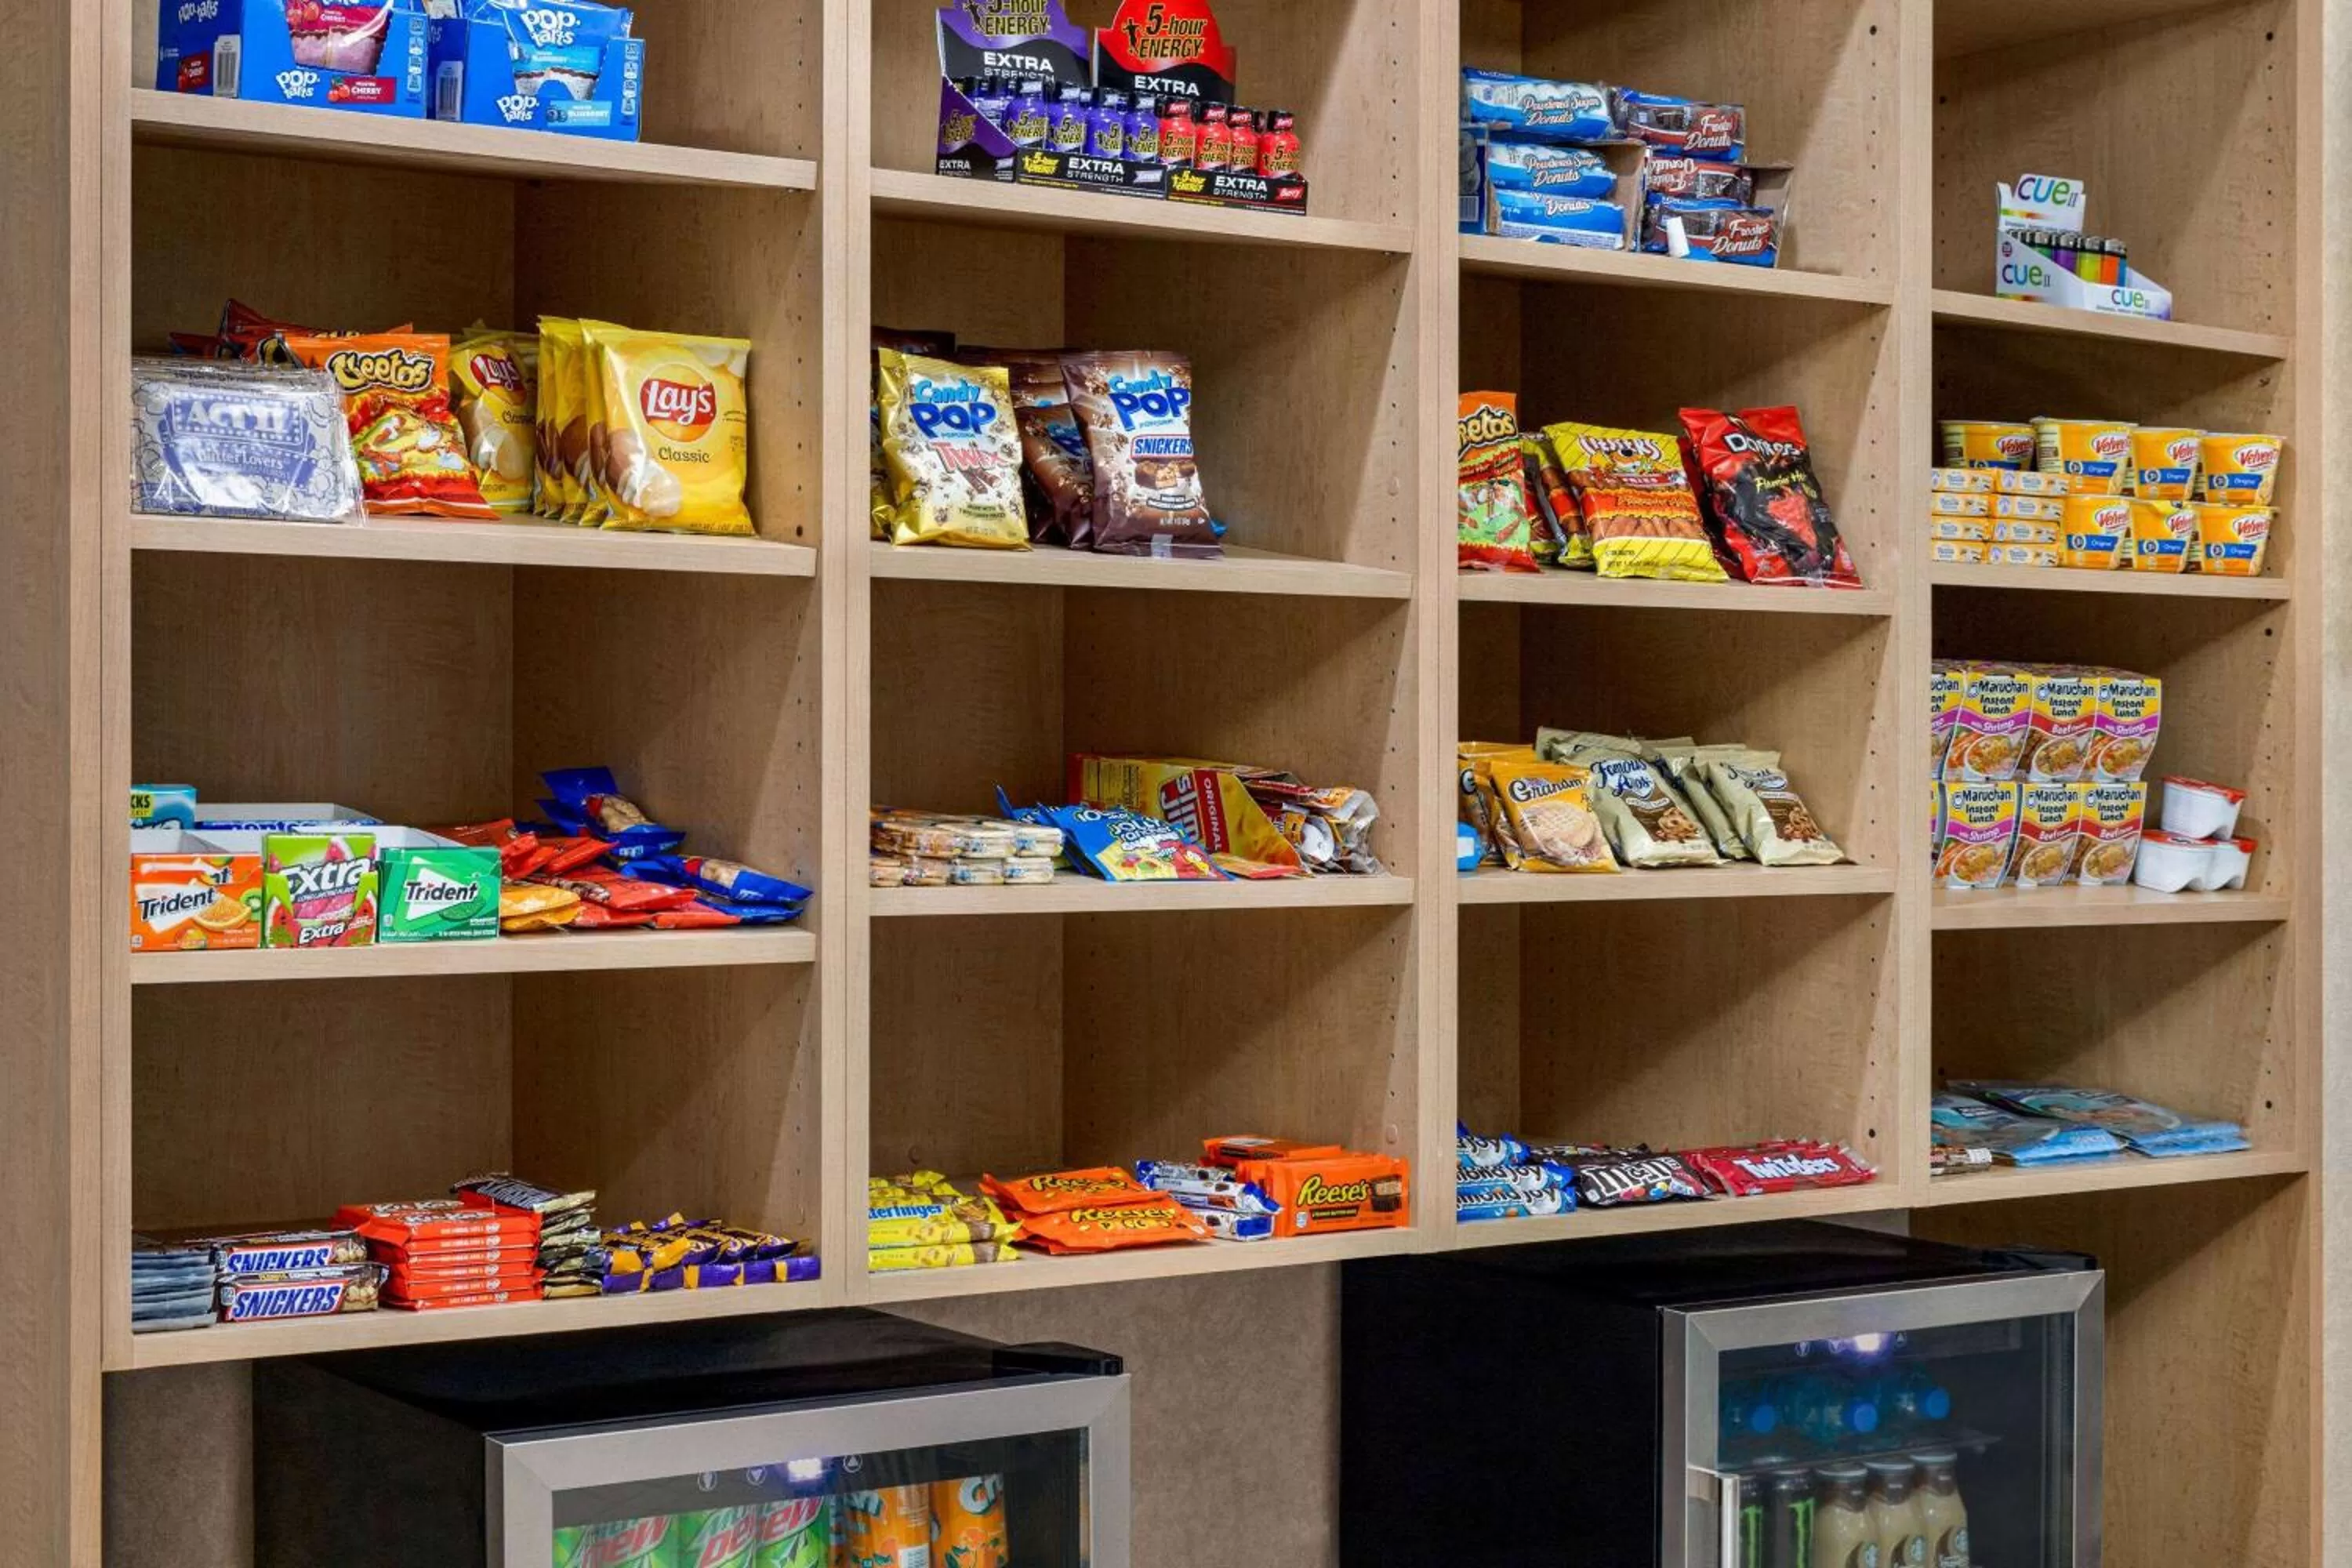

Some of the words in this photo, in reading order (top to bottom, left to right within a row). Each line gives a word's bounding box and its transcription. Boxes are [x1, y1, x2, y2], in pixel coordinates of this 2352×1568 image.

[985, 15, 1049, 35] ENERGY
[1145, 3, 1207, 36] 5-hour
[1138, 37, 1204, 60] ENERGY
[984, 51, 1054, 72] EXTRA
[1134, 74, 1200, 96] EXTRA
[1526, 112, 1573, 126] Donuts
[1685, 131, 1731, 151] Donuts
[939, 159, 971, 170] EXTRA
[1069, 158, 1125, 175] EXTRA
[1066, 170, 1124, 183] STRENGTH
[1215, 175, 1268, 192] EXTRA
[1533, 170, 1580, 187] Donuts
[1213, 187, 1268, 201] STRENGTH
[2017, 175, 2070, 205] cue
[1711, 236, 1763, 256] Donuts
[2002, 264, 2042, 286] cue
[2111, 289, 2143, 308] cue
[1109, 369, 1172, 393] Candy
[914, 378, 981, 405] Candy
[645, 380, 714, 426] Lay's
[1134, 437, 1193, 456] SNICKERS
[242, 450, 284, 470] Lovers
[658, 446, 710, 463] Classic
[1978, 681, 2029, 694] Maruchan
[2047, 683, 2094, 695] Maruchan
[2109, 684, 2156, 697] Maruchan
[1980, 695, 2016, 706] Instant
[2049, 697, 2082, 709] Instant
[2112, 698, 2146, 709] Instant
[1983, 704, 2011, 714] Lunch
[2052, 706, 2078, 717] Lunch
[2114, 707, 2142, 717] Lunch
[1983, 720, 2016, 732] Shrimp
[2052, 724, 2071, 735] Beef
[2116, 723, 2146, 735] Shrimp
[1962, 789, 2011, 802] Maruchan
[2034, 789, 2078, 802] Maruchan
[2095, 789, 2141, 801] Maruchan
[1203, 777, 1221, 849] ORIGINAL
[1965, 804, 1999, 815] Instant
[2038, 804, 2067, 814] Instant
[2097, 803, 2129, 813] Instant
[1969, 813, 1995, 823] Lunch
[2039, 813, 2063, 822] Lunch
[2100, 811, 2125, 822] Lunch
[1969, 829, 1999, 841] Shrimp
[405, 882, 478, 901] Trident
[137, 887, 216, 920] Trident
[299, 922, 346, 945] Extra
[1298, 1174, 1370, 1206] Reese's
[228, 1247, 330, 1273] SNICKERS
[234, 1286, 341, 1318] SNICKERS
